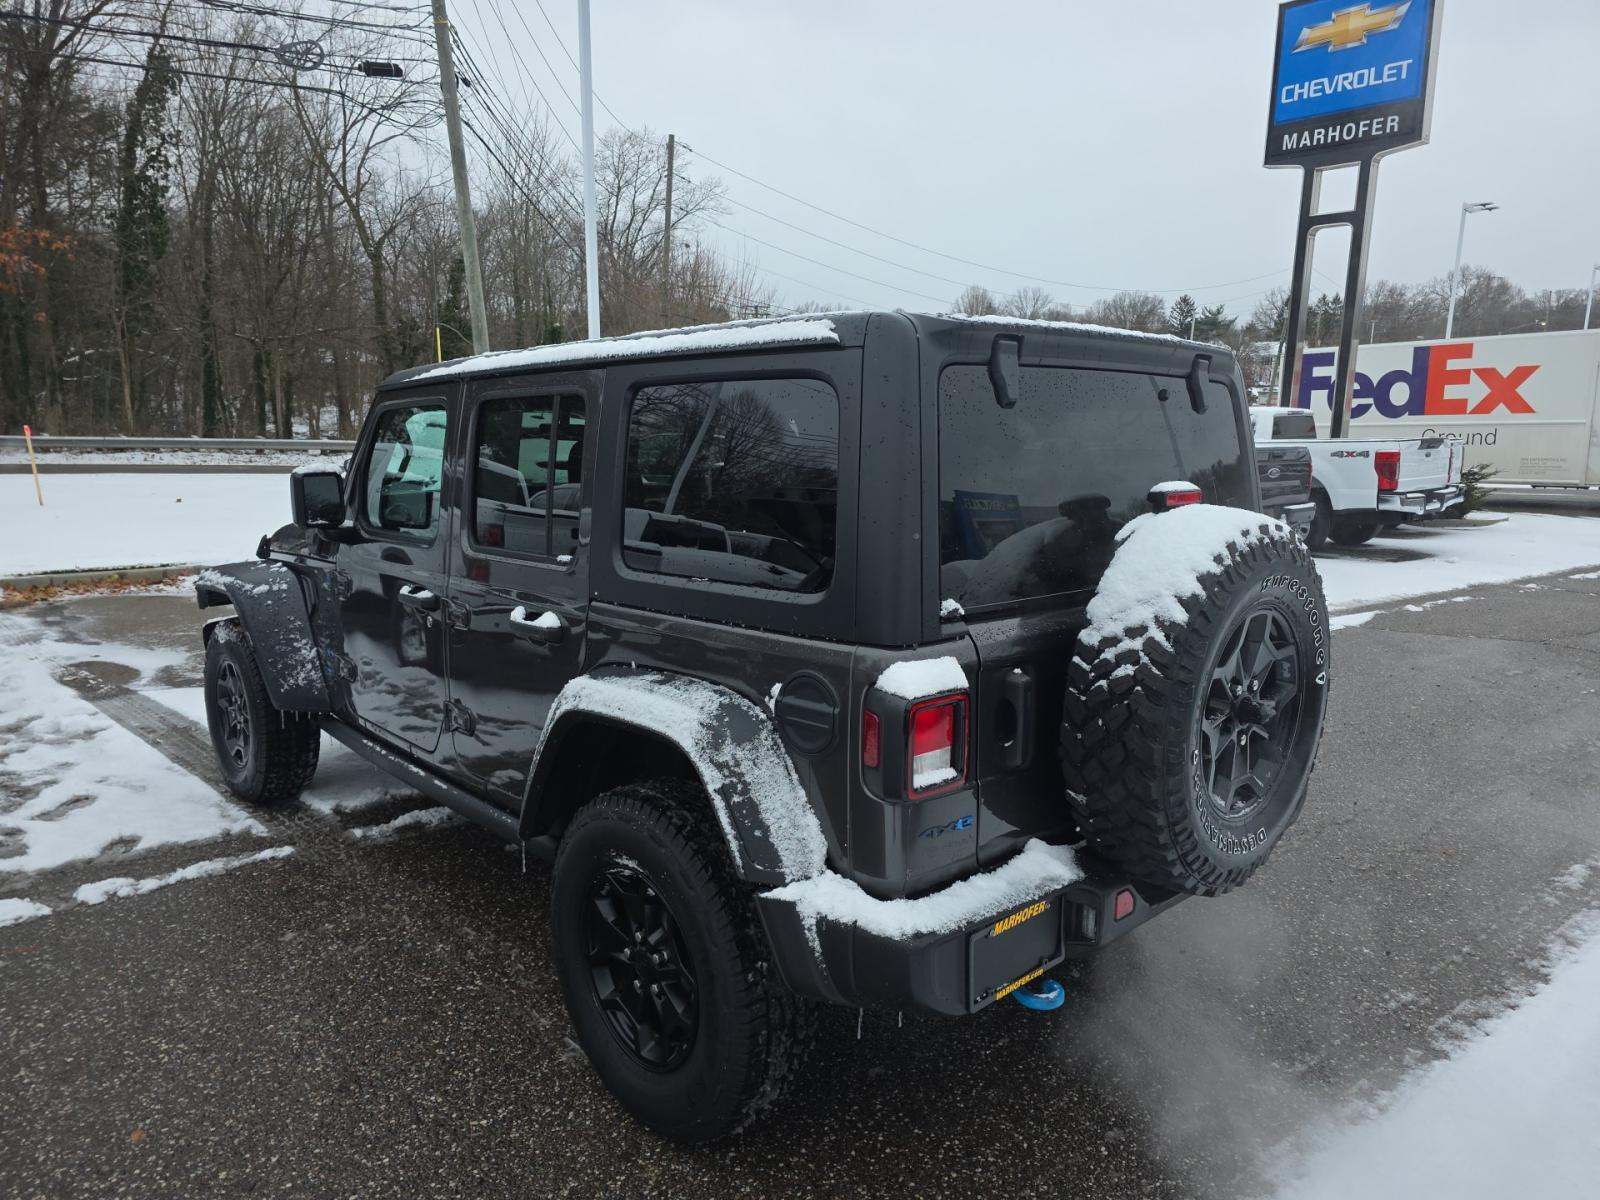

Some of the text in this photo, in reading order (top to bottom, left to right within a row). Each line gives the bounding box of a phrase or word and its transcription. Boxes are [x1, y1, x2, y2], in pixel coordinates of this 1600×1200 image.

[1281, 59, 1413, 104] CHEVROLET
[1282, 115, 1400, 150] MARHOFER
[1300, 343, 1541, 419] FedEx
[1260, 575, 1326, 666] Firestone
[993, 900, 1047, 937] MARHOFER
